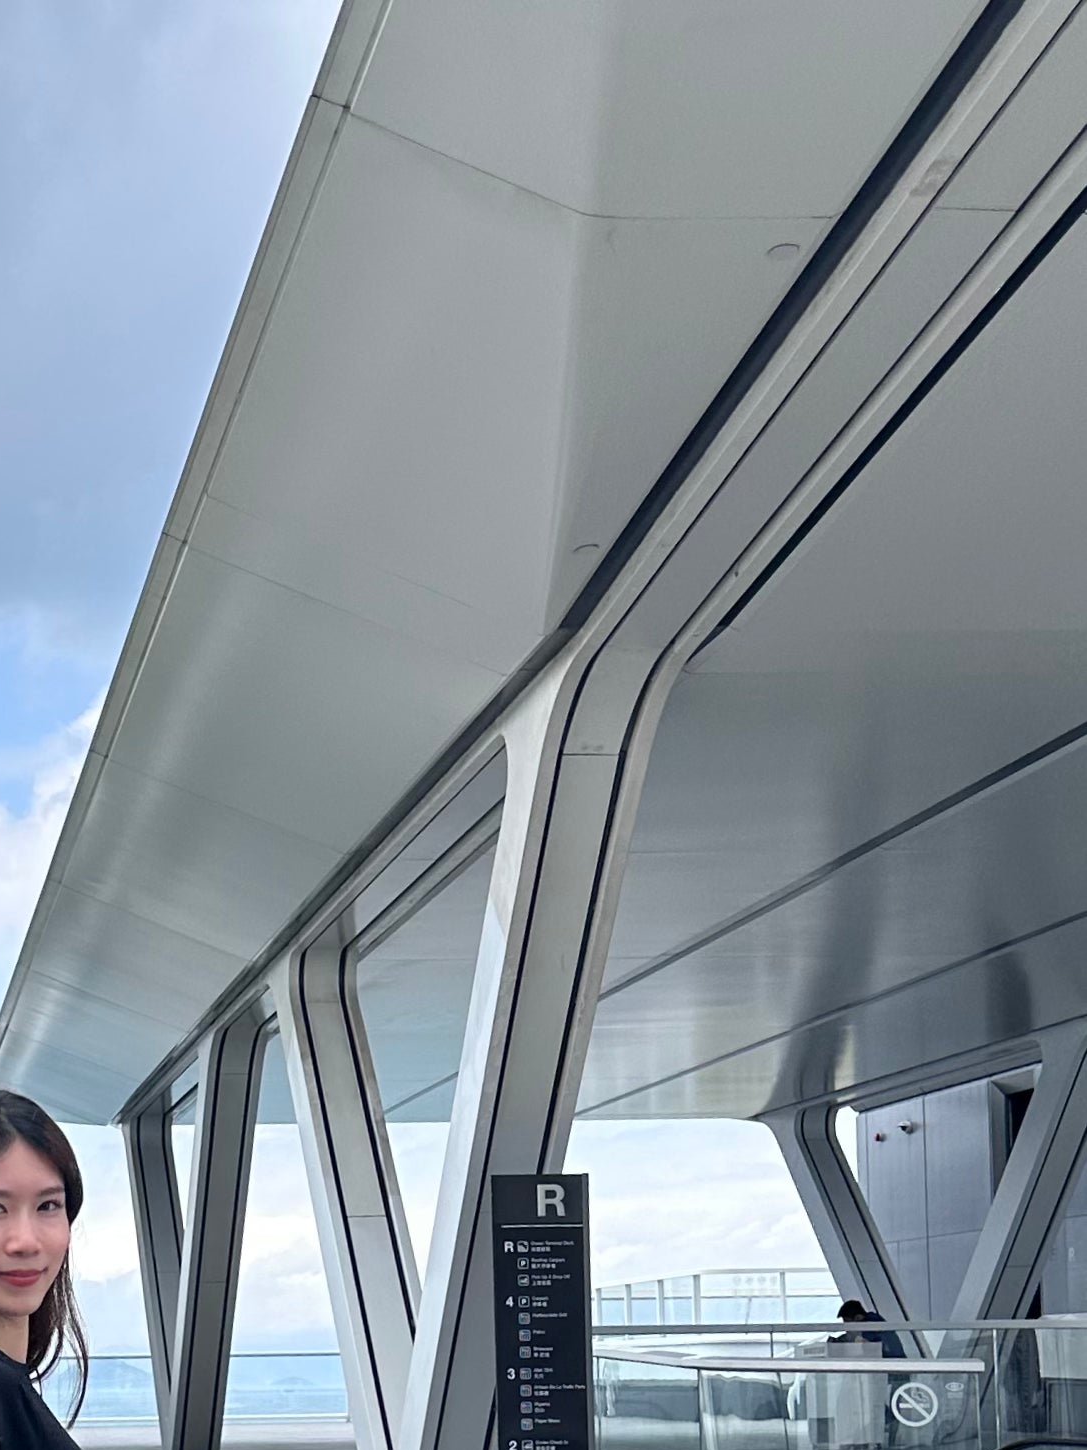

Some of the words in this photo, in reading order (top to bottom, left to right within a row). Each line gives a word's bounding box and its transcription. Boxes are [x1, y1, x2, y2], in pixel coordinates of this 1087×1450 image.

[536, 1183, 566, 1217] R
[504, 1241, 514, 1253] R
[505, 1296, 514, 1308] 4
[507, 1368, 516, 1380] 3
